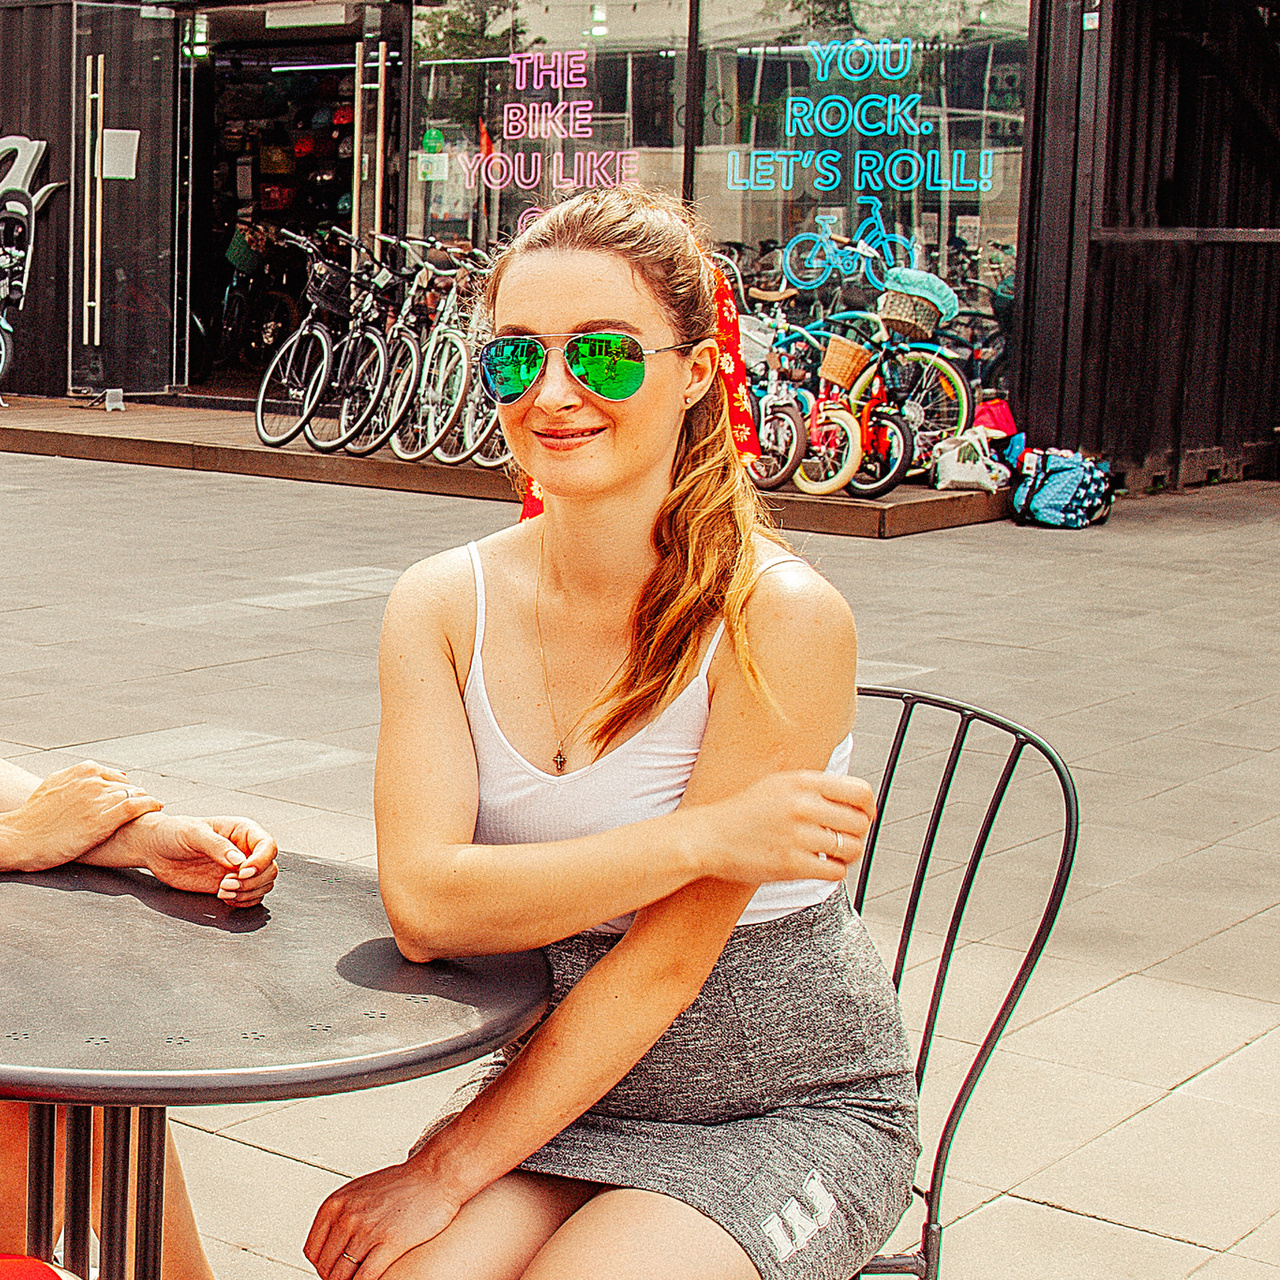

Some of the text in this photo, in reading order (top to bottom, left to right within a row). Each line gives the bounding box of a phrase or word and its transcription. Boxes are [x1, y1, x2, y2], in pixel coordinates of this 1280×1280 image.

[509, 50, 587, 90] THE
[807, 37, 913, 82] YOU
[503, 100, 594, 139] BIKE
[785, 94, 933, 137] ROCK.
[457, 152, 542, 190] YOU
[552, 151, 640, 189] LIKE
[726, 148, 993, 191] LET'S ROLL!
